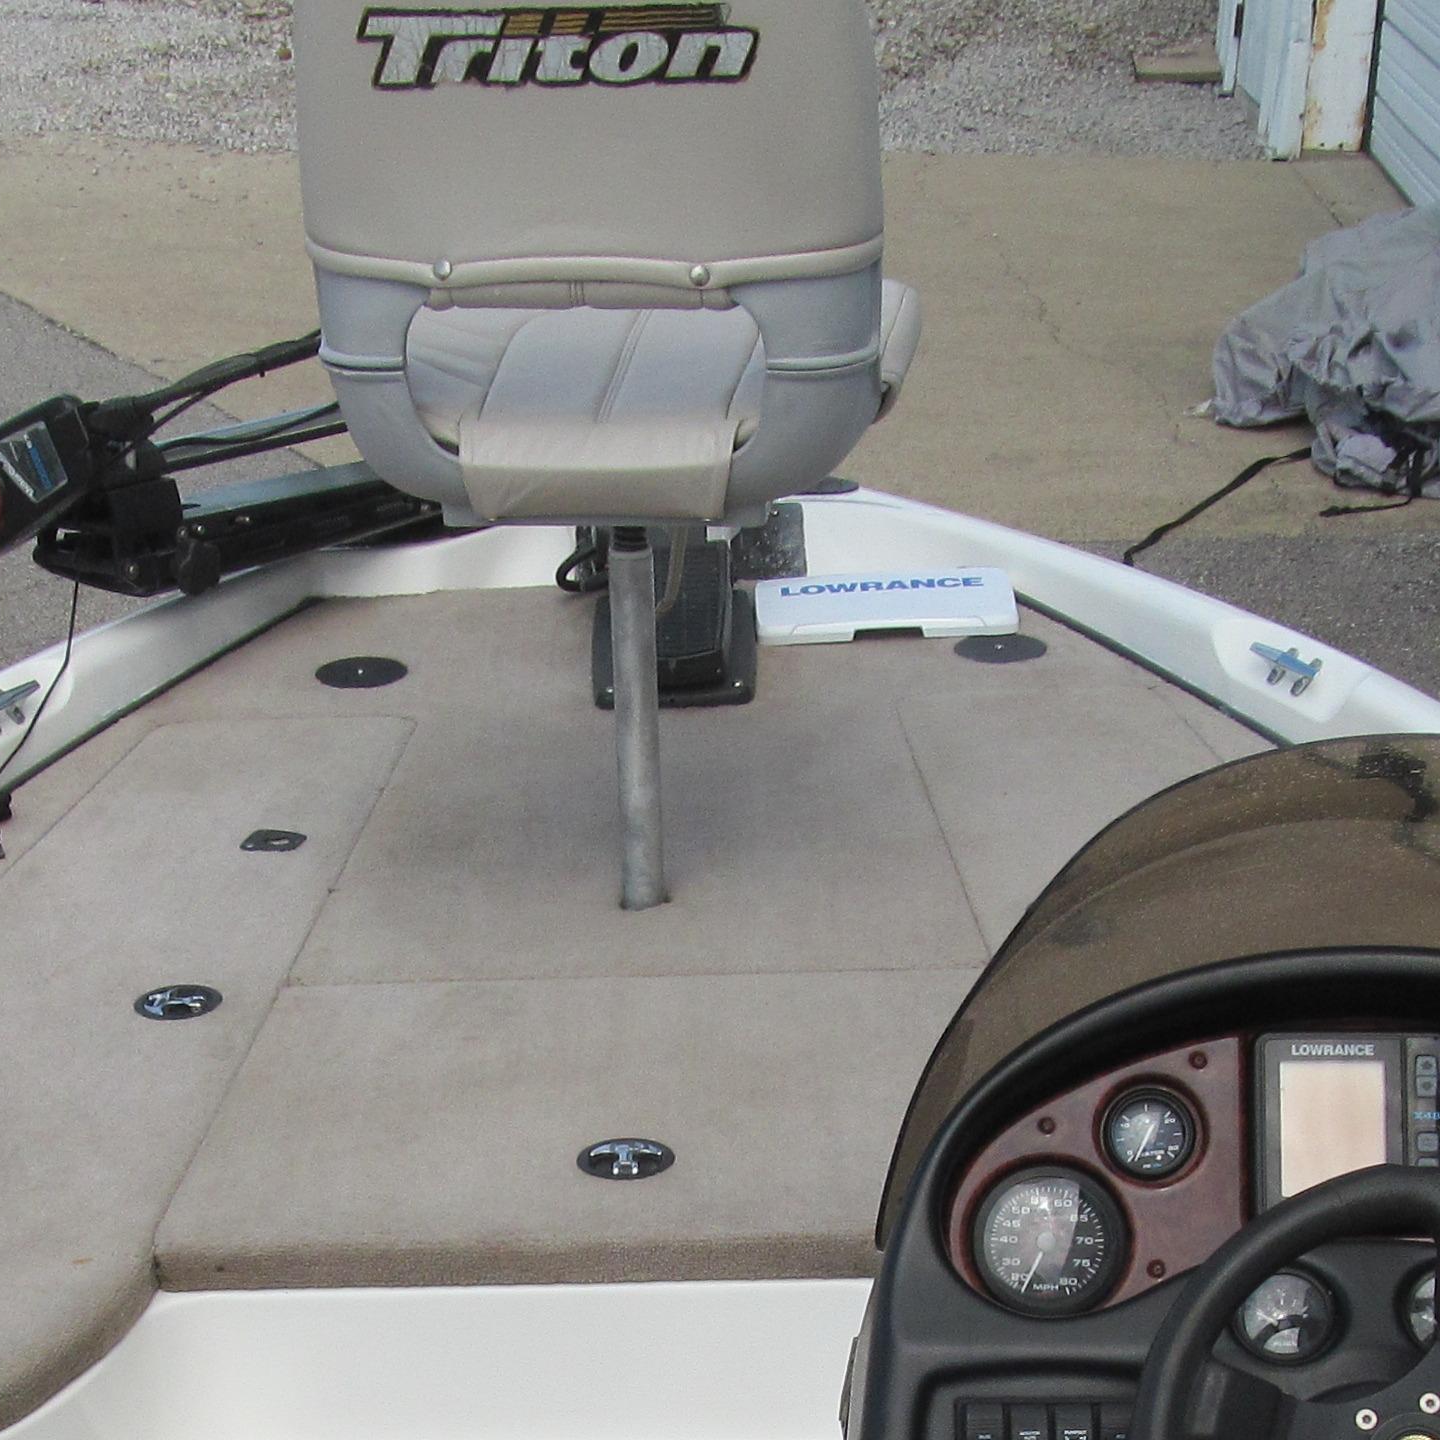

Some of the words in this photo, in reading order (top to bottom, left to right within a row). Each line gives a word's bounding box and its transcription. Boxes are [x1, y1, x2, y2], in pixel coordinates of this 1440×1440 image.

[358, 9, 759, 88] Triton
[780, 576, 984, 597] LOWRANCE
[1291, 1044, 1375, 1056] LOWRANCE
[1054, 1199, 1073, 1208] 60
[1011, 1206, 1031, 1215] 50
[1070, 1214, 1089, 1223] 65
[1002, 1219, 1022, 1228] 45
[999, 1235, 1019, 1244] 40
[1075, 1236, 1094, 1245] 70
[1002, 1257, 1021, 1266] 30
[1072, 1258, 1091, 1267] 75
[1059, 1277, 1079, 1286] 80
[1032, 1283, 1060, 1291] MPH
